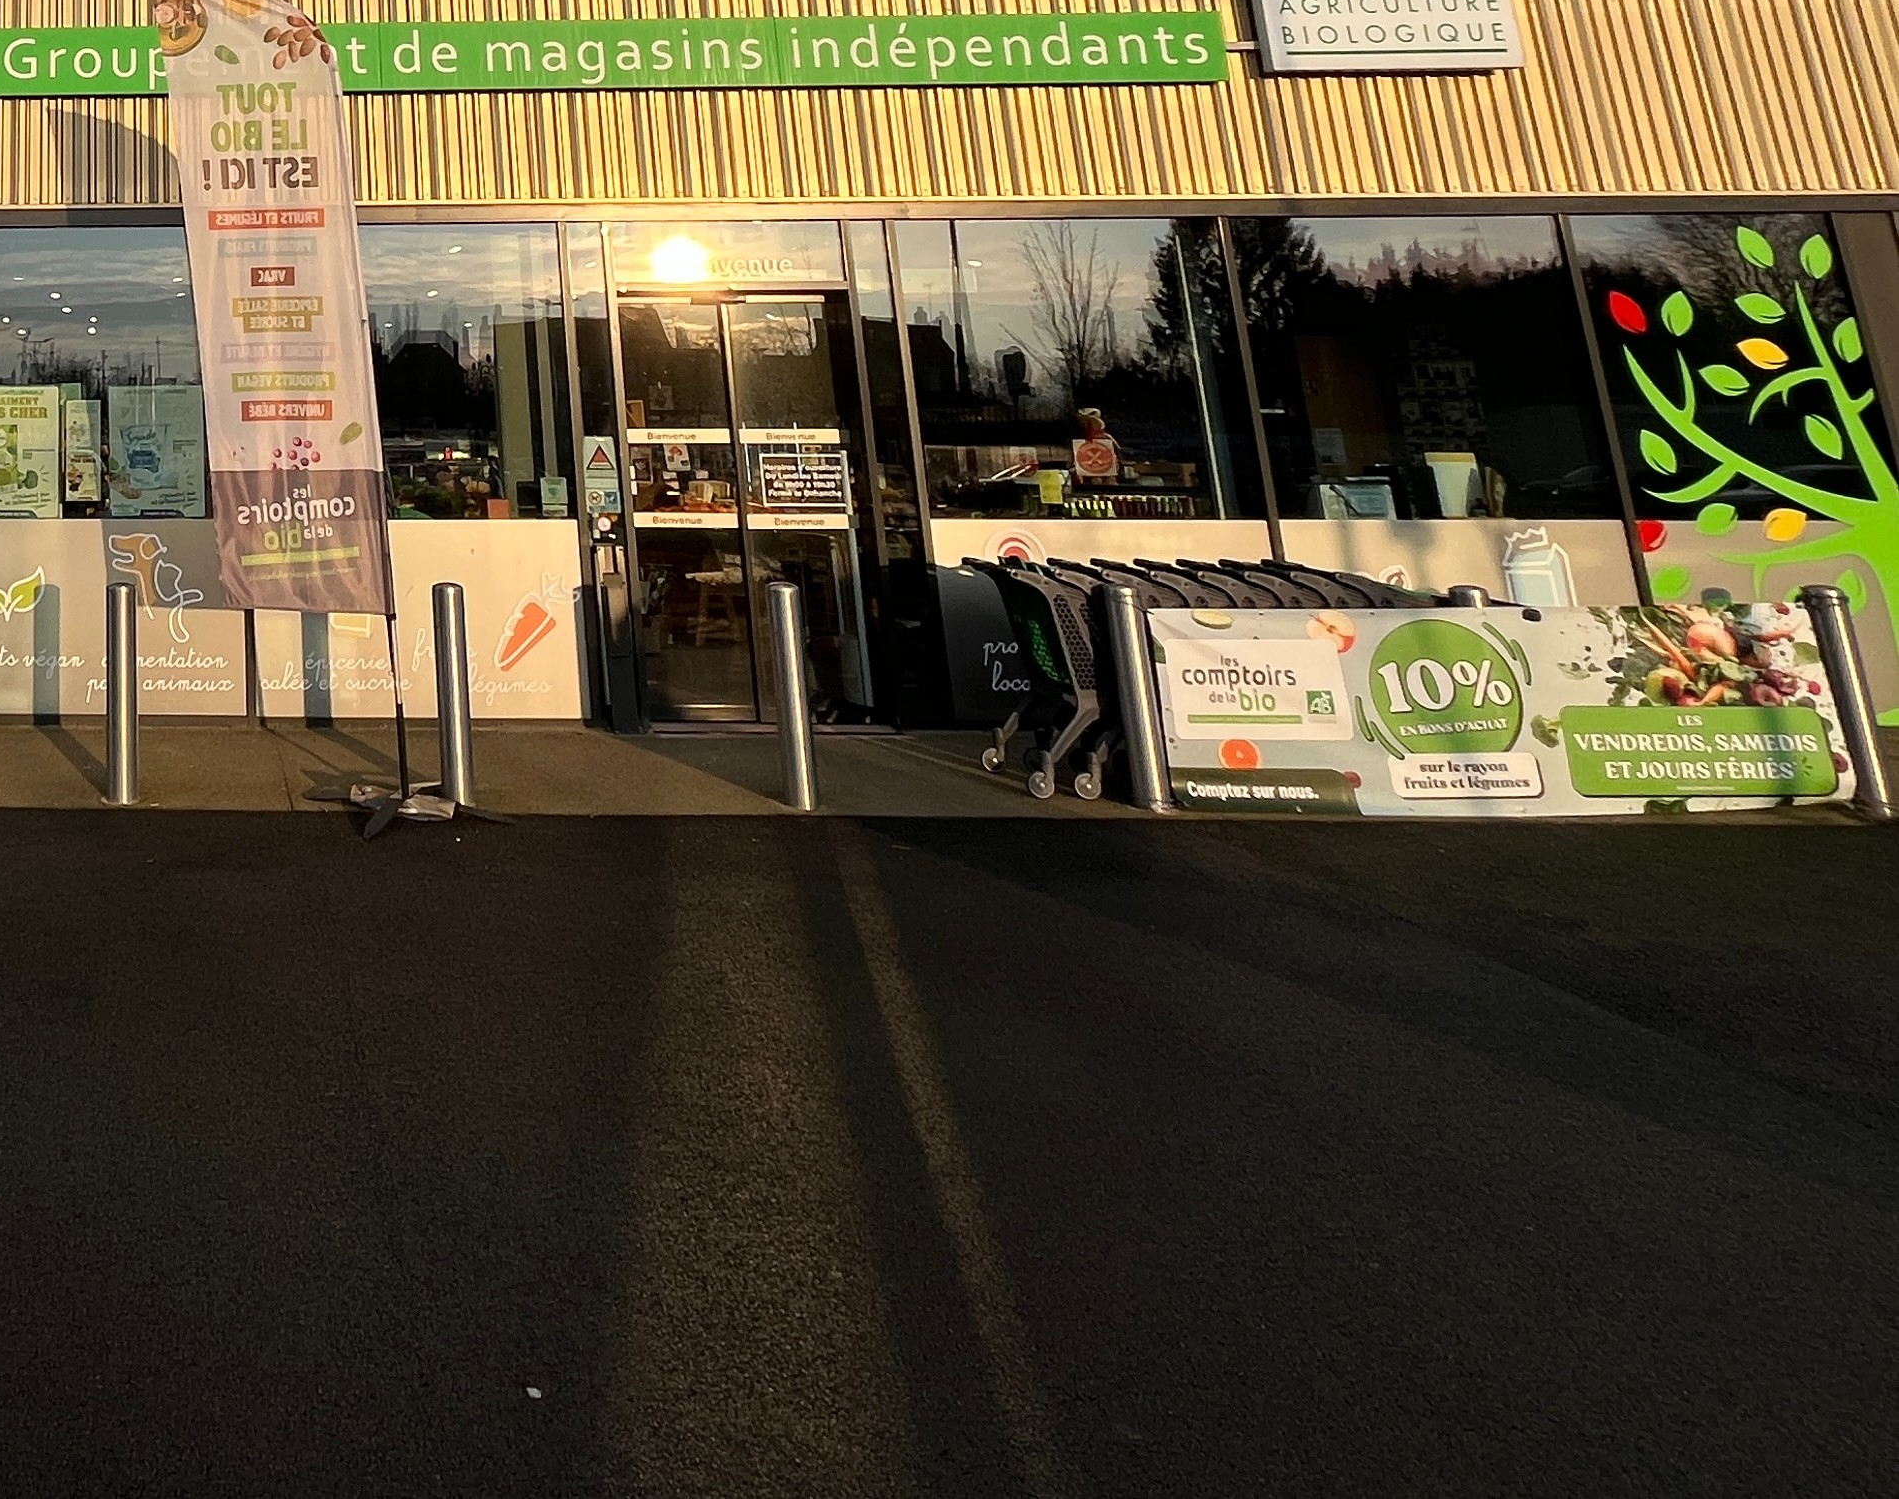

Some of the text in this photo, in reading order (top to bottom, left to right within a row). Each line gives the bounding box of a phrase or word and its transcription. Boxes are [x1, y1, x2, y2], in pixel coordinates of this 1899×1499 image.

[1282, 22, 1509, 46] BIOLOGIQUE
[393, 29, 457, 74] de
[485, 30, 763, 84] magasins
[791, 21, 1209, 80] indépendants
[9, 406, 48, 419] CHER
[647, 432, 697, 441] Bienvenue
[652, 516, 702, 525] Bienvenue
[774, 517, 825, 526] Bienvenue
[23, 649, 85, 679] végan
[305, 652, 389, 682] épicerie
[1220, 655, 1239, 667] les
[143, 675, 235, 692] animaux
[261, 660, 412, 691] salée et sucre
[469, 662, 553, 706] légumes
[1182, 665, 1297, 691] comptoirs
[1378, 658, 1512, 715] 10%
[1209, 691, 1223, 704] de
[1239, 689, 1276, 712] bio
[1399, 717, 1508, 737] EN BONS D'ACHAT
[1677, 715, 1703, 727] LES
[1573, 733, 1818, 754] VENDREDIS, SAMEDIS
[1419, 760, 1509, 777] sur le rayon
[1604, 761, 1632, 779] ET
[1636, 761, 1711, 780] JOURS
[1187, 781, 1320, 800] Comptez sur nous.
[1404, 775, 1531, 792] fruits et légumes
